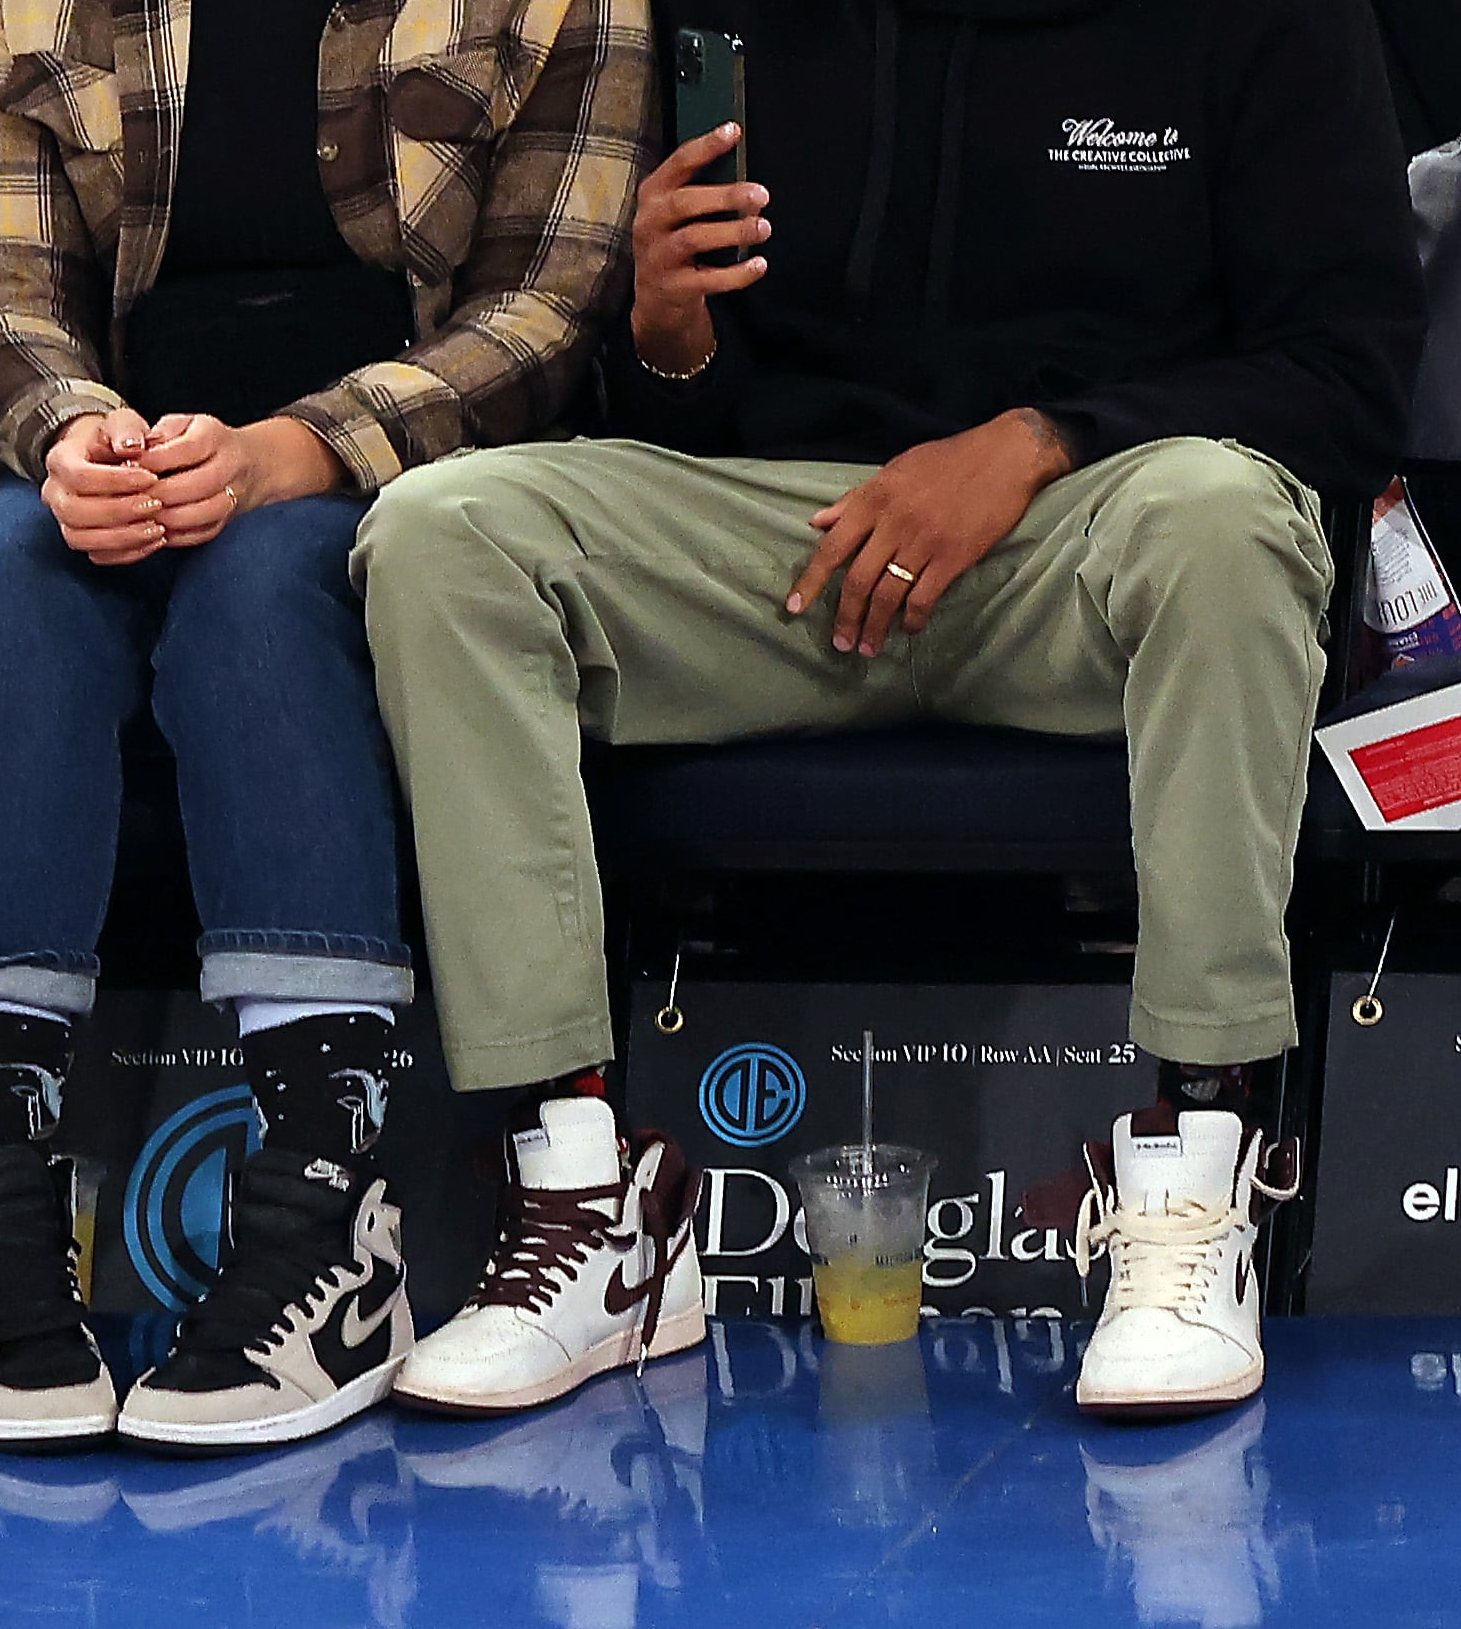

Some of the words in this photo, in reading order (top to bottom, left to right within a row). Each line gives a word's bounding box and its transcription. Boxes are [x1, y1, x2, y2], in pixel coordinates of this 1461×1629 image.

[1062, 118, 1157, 147] Welcome
[1048, 149, 1070, 161] THE
[1071, 150, 1127, 163] CREATIVE
[1128, 148, 1191, 163] COLLECTIVE
[111, 1049, 176, 1066] Section
[180, 1048, 215, 1066] VIP
[902, 1044, 937, 1062] VIP
[981, 1046, 1019, 1064] Row
[1023, 1045, 1052, 1064] AA
[1064, 1045, 1101, 1064] Seat
[1109, 1044, 1135, 1064] 25
